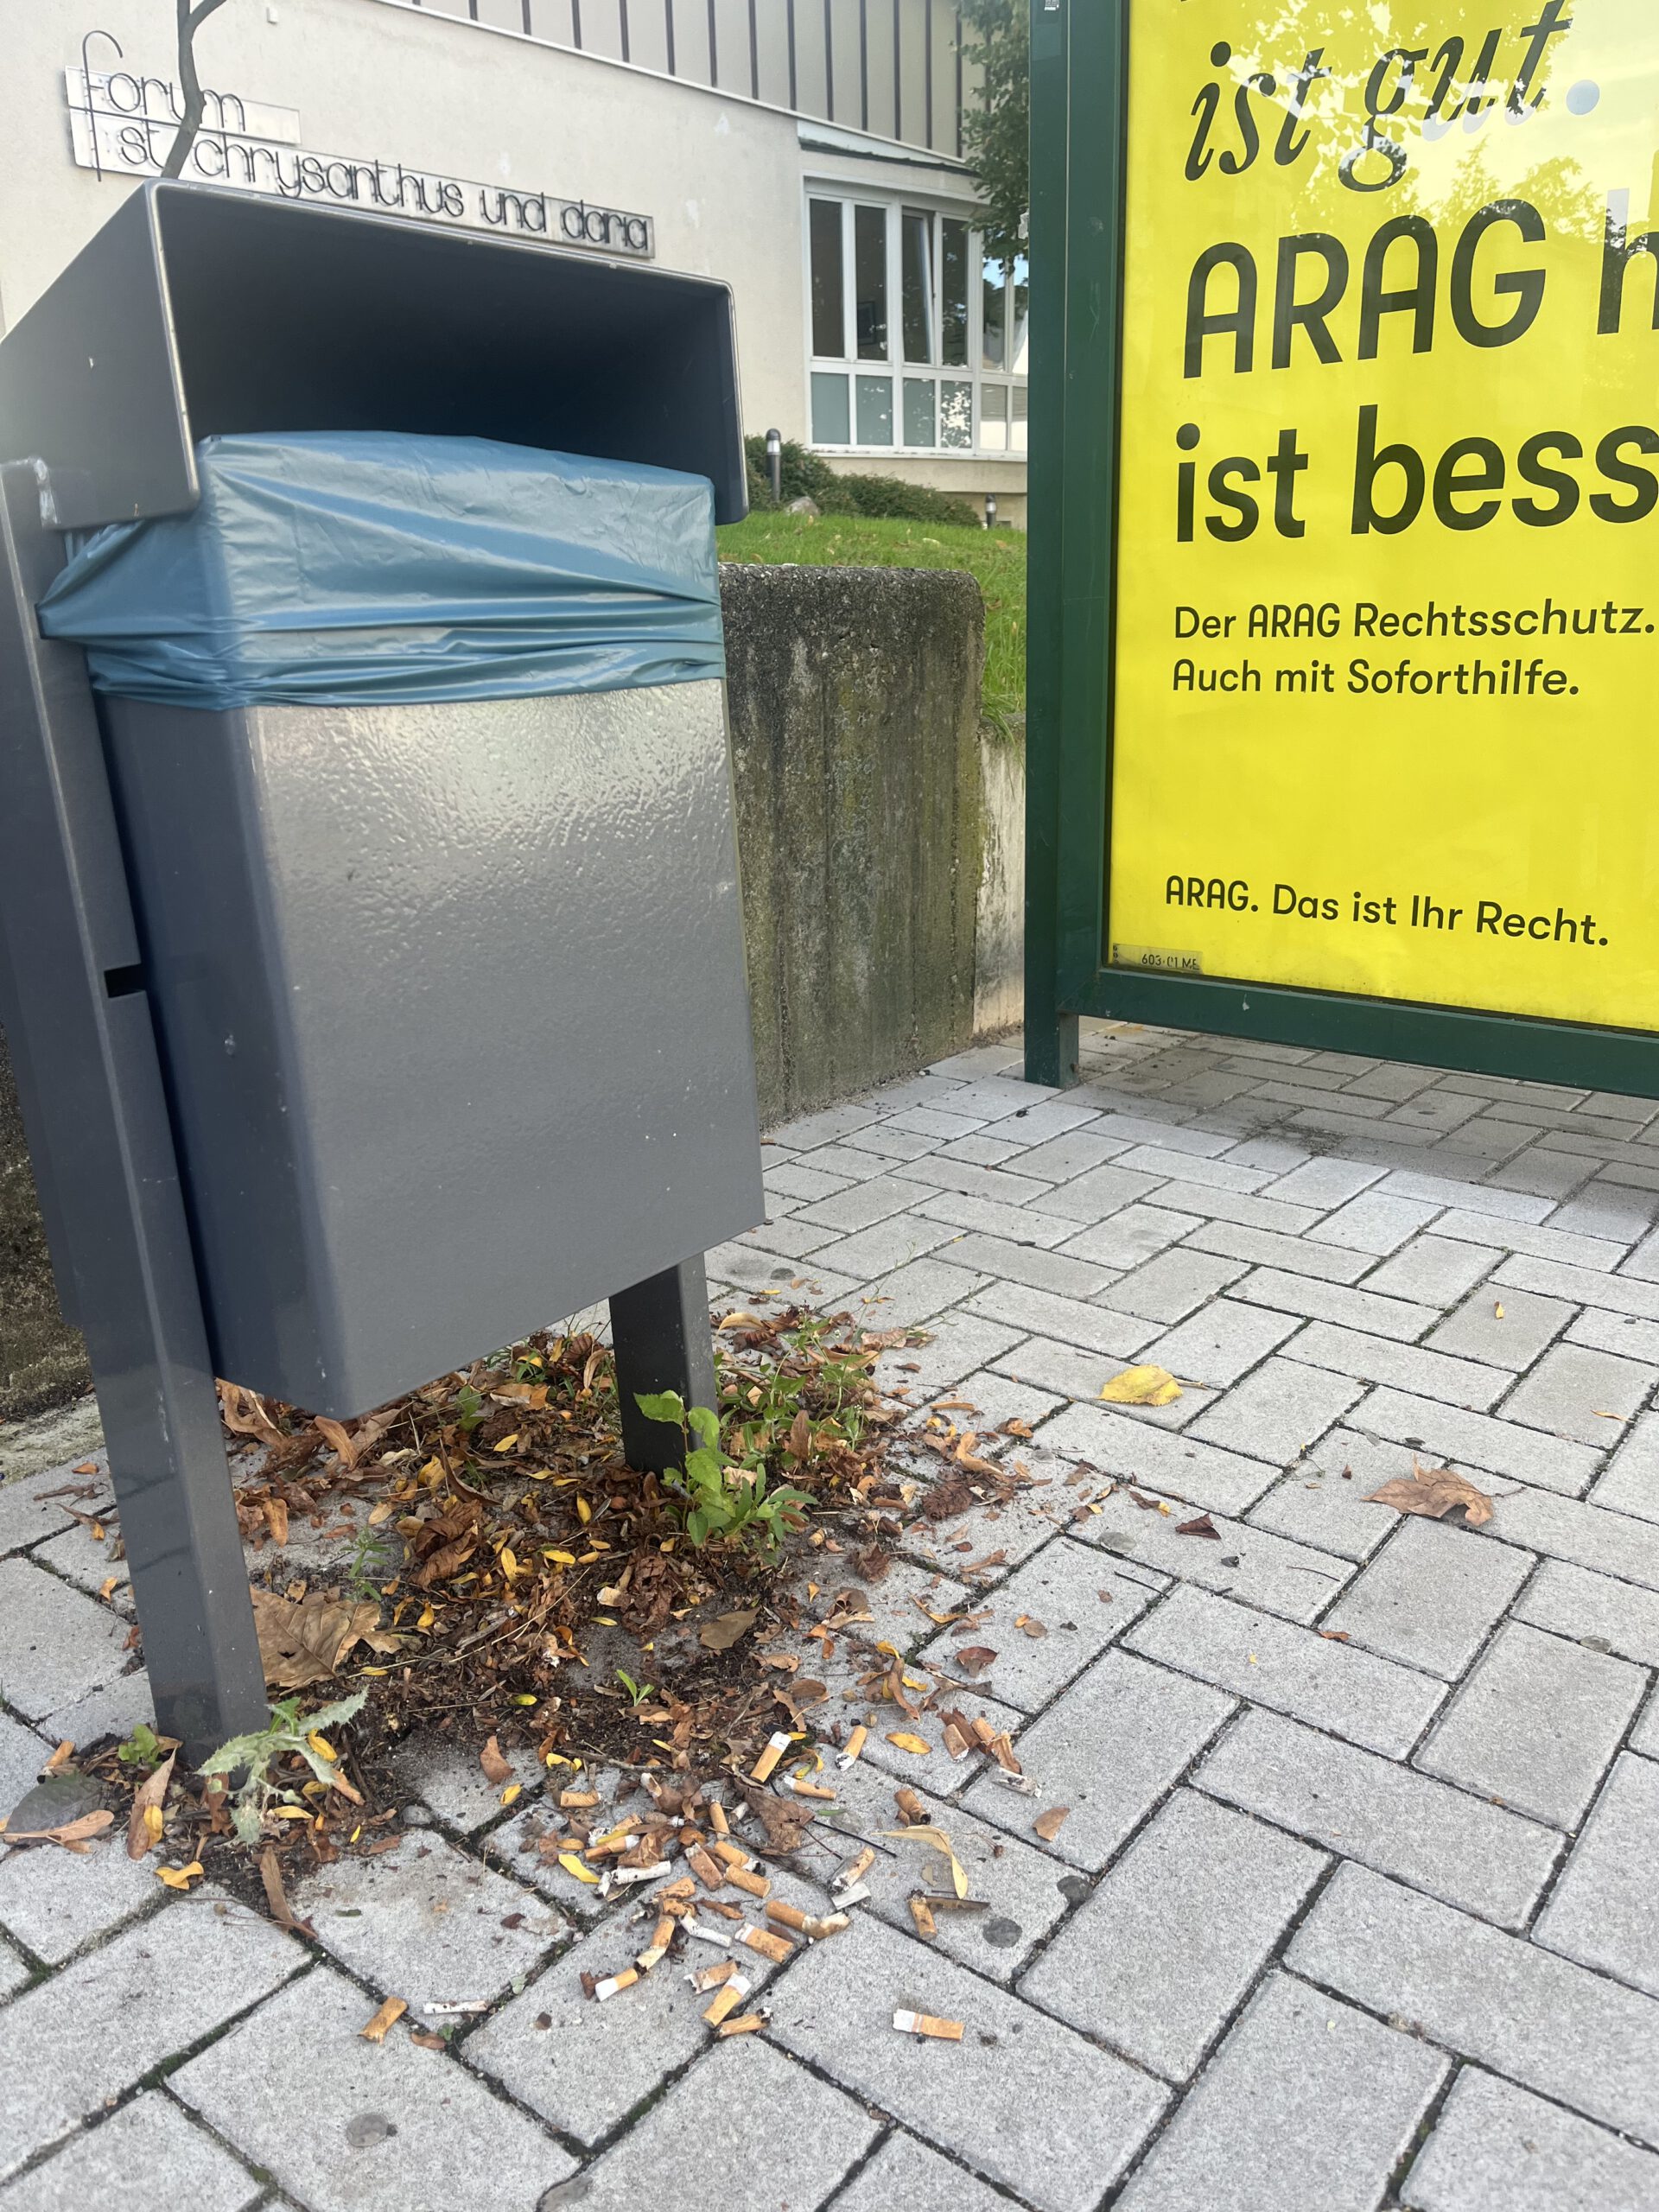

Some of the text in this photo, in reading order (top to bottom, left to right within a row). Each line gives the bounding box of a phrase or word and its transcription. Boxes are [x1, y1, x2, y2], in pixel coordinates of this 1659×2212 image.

[1185, 0, 1600, 193] ist gut.
[194, 133, 464, 217] chrysanthus
[480, 190, 546, 232] und
[562, 199, 648, 251] daria
[1183, 198, 1547, 379] ARAG
[1176, 404, 1659, 543] ist bess
[1173, 658, 1580, 696] Auch mit Soforthilfe.
[1175, 598, 1655, 639] Der ARAG Rechtsschutz.
[1166, 875, 1608, 946] ARAG. Das ist Ihr Recht.
